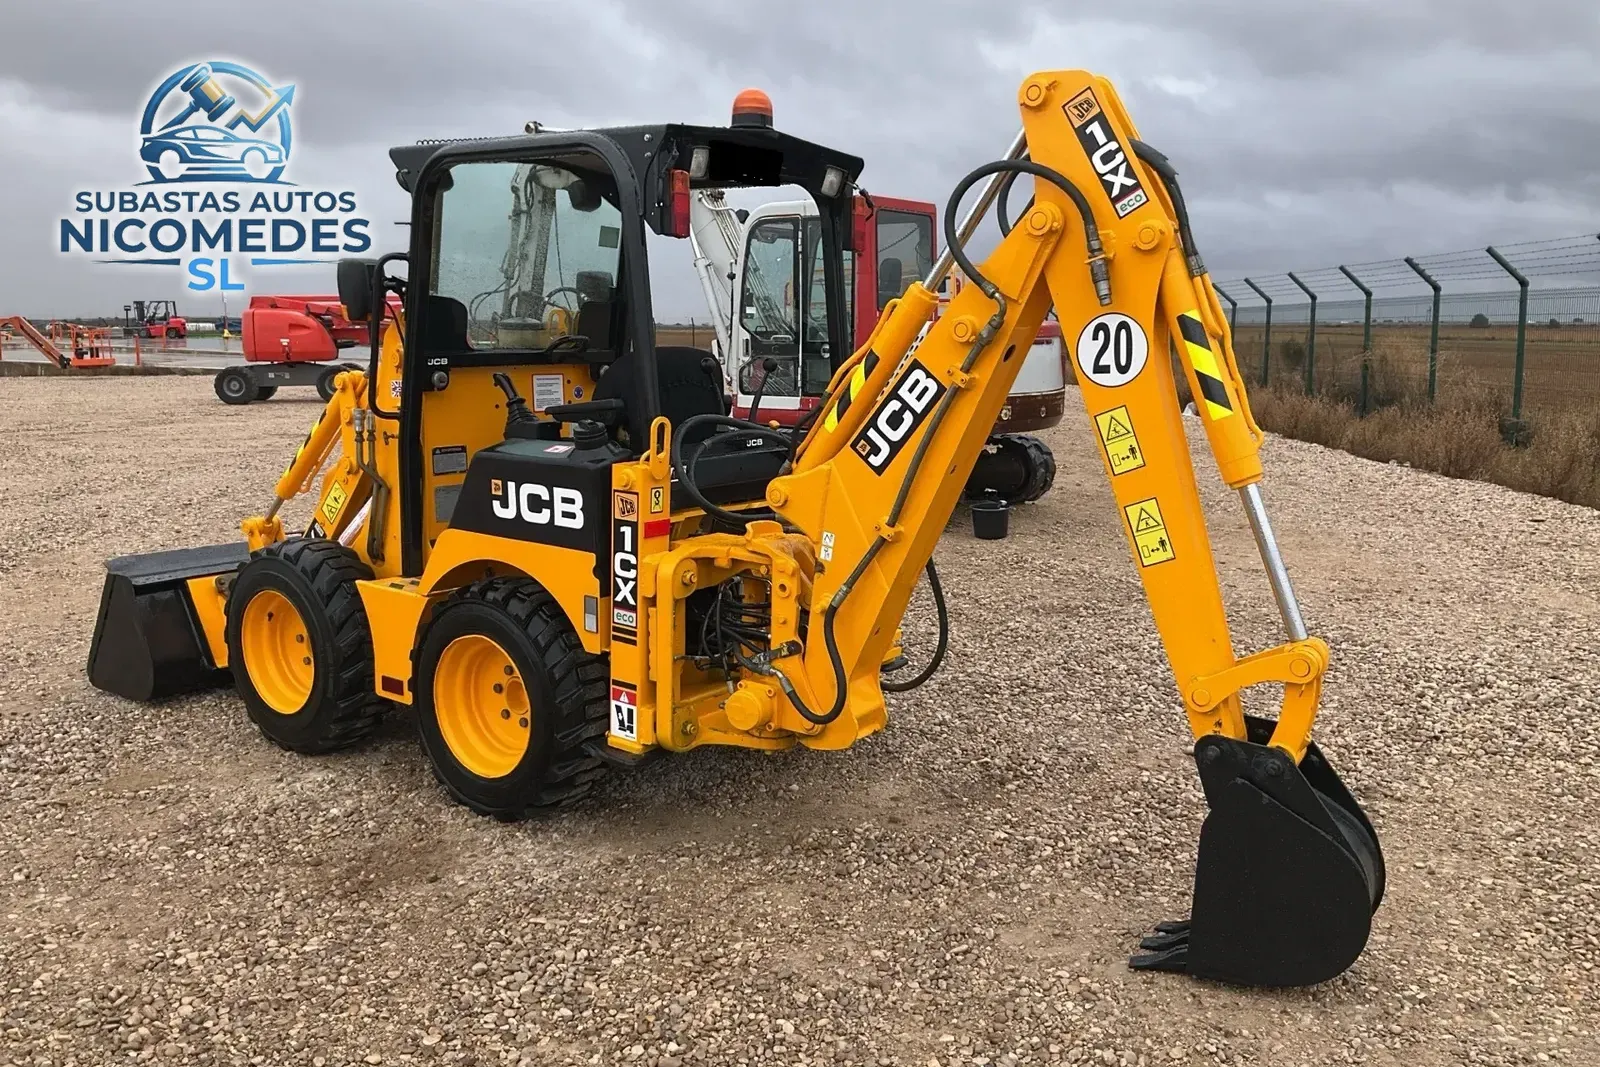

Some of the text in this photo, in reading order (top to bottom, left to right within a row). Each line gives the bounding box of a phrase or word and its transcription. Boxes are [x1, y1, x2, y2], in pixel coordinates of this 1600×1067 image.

[1073, 99, 1094, 119] JCB
[1085, 120, 1138, 199] 1CX
[1120, 196, 1143, 212] eco
[1092, 320, 1133, 375] 20
[427, 357, 449, 366] JCB
[866, 368, 938, 467] JCB
[746, 438, 763, 447] JCB
[492, 481, 585, 530] JCB
[619, 499, 635, 517] JCB
[614, 525, 637, 606] 1CX
[616, 612, 635, 624] eco
